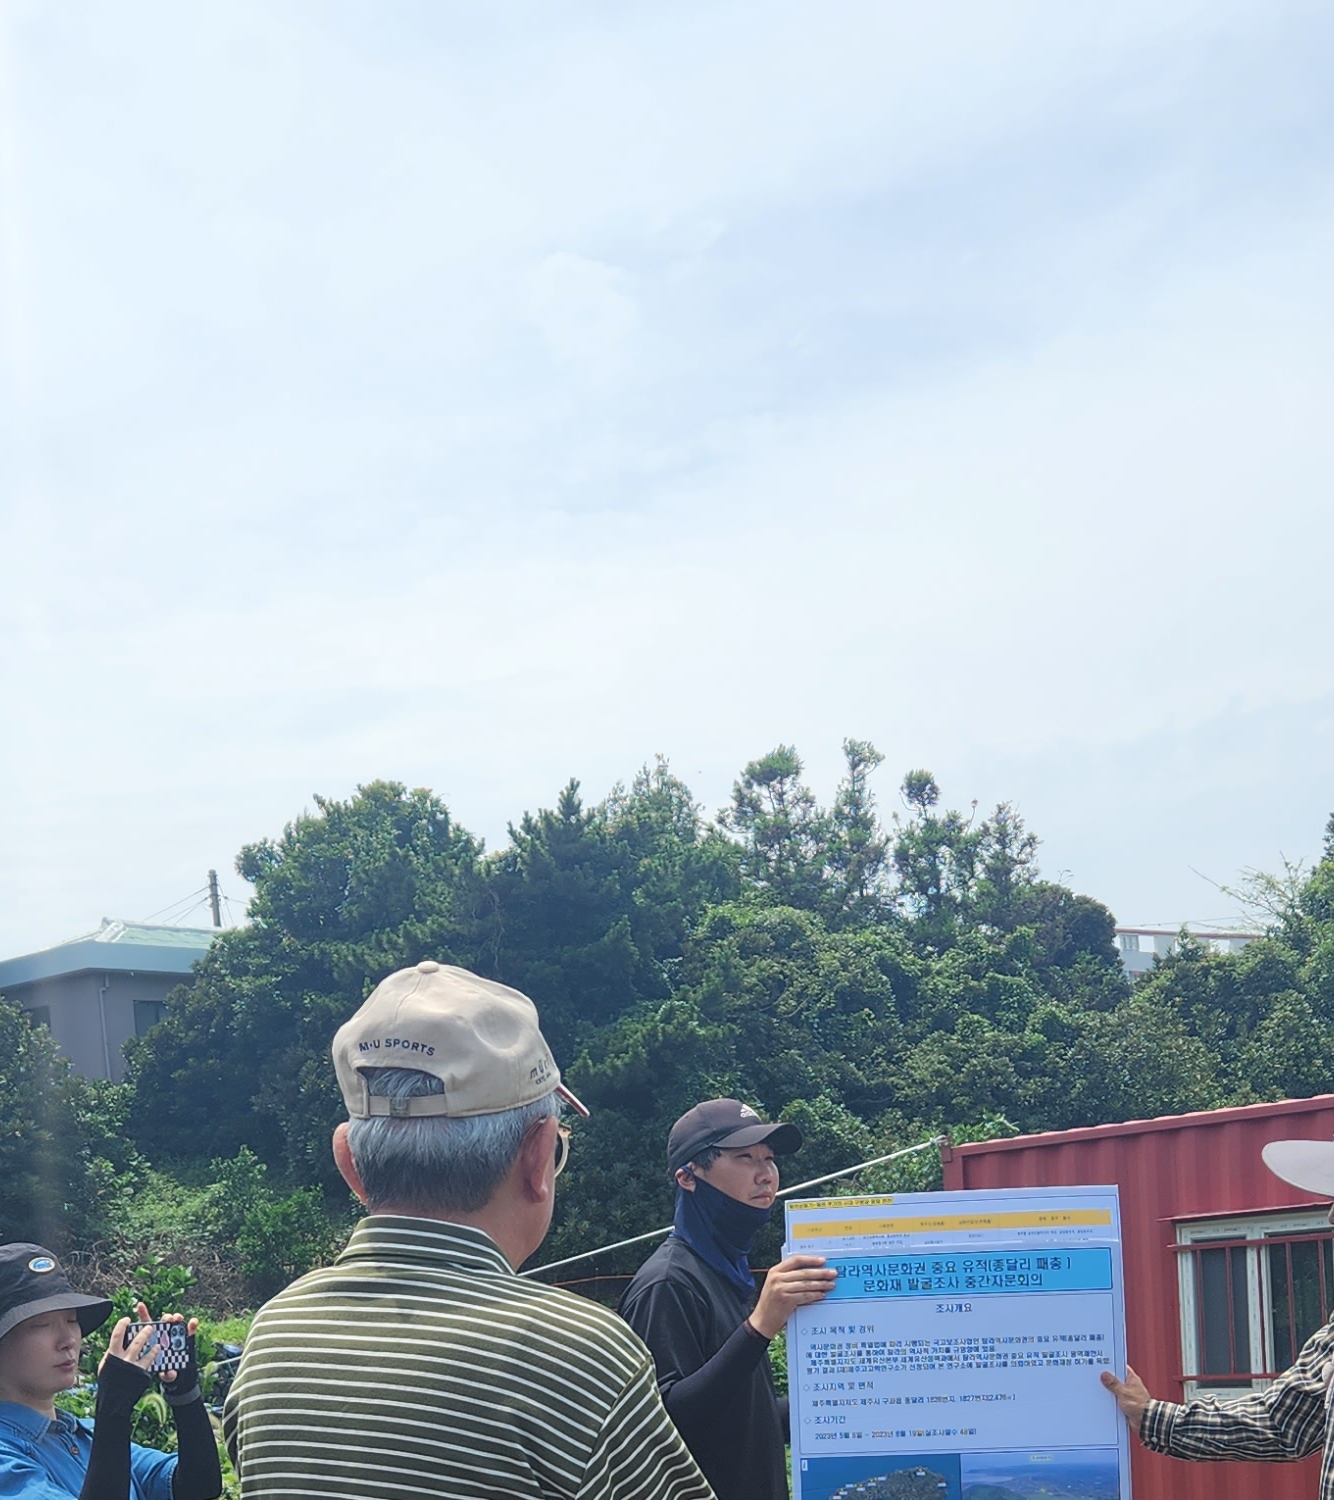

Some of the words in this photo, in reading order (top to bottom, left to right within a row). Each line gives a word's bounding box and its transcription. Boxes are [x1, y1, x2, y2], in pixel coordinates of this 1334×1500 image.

[385, 1038, 435, 1056] SPORTS
[835, 1260, 926, 1279] 탐라역사문화권
[931, 1259, 955, 1275] 중요
[1035, 1255, 1060, 1272] 패총
[862, 1276, 902, 1293] 문화재
[907, 1274, 959, 1291] 발굴조사
[963, 1272, 1043, 1289] 중간자문회의
[935, 1302, 972, 1314] 조사개요
[829, 1325, 845, 1335] 목적
[848, 1325, 856, 1334] 및
[858, 1324, 874, 1334] 경위
[813, 1382, 845, 1391] 조사지역
[848, 1381, 855, 1390] 및
[858, 1381, 874, 1390] 면적
[860, 1397, 880, 1406] 제주시
[814, 1415, 846, 1424] 조사기간
[815, 1432, 838, 1440] 2023년
[871, 1430, 894, 1438] 2023년
